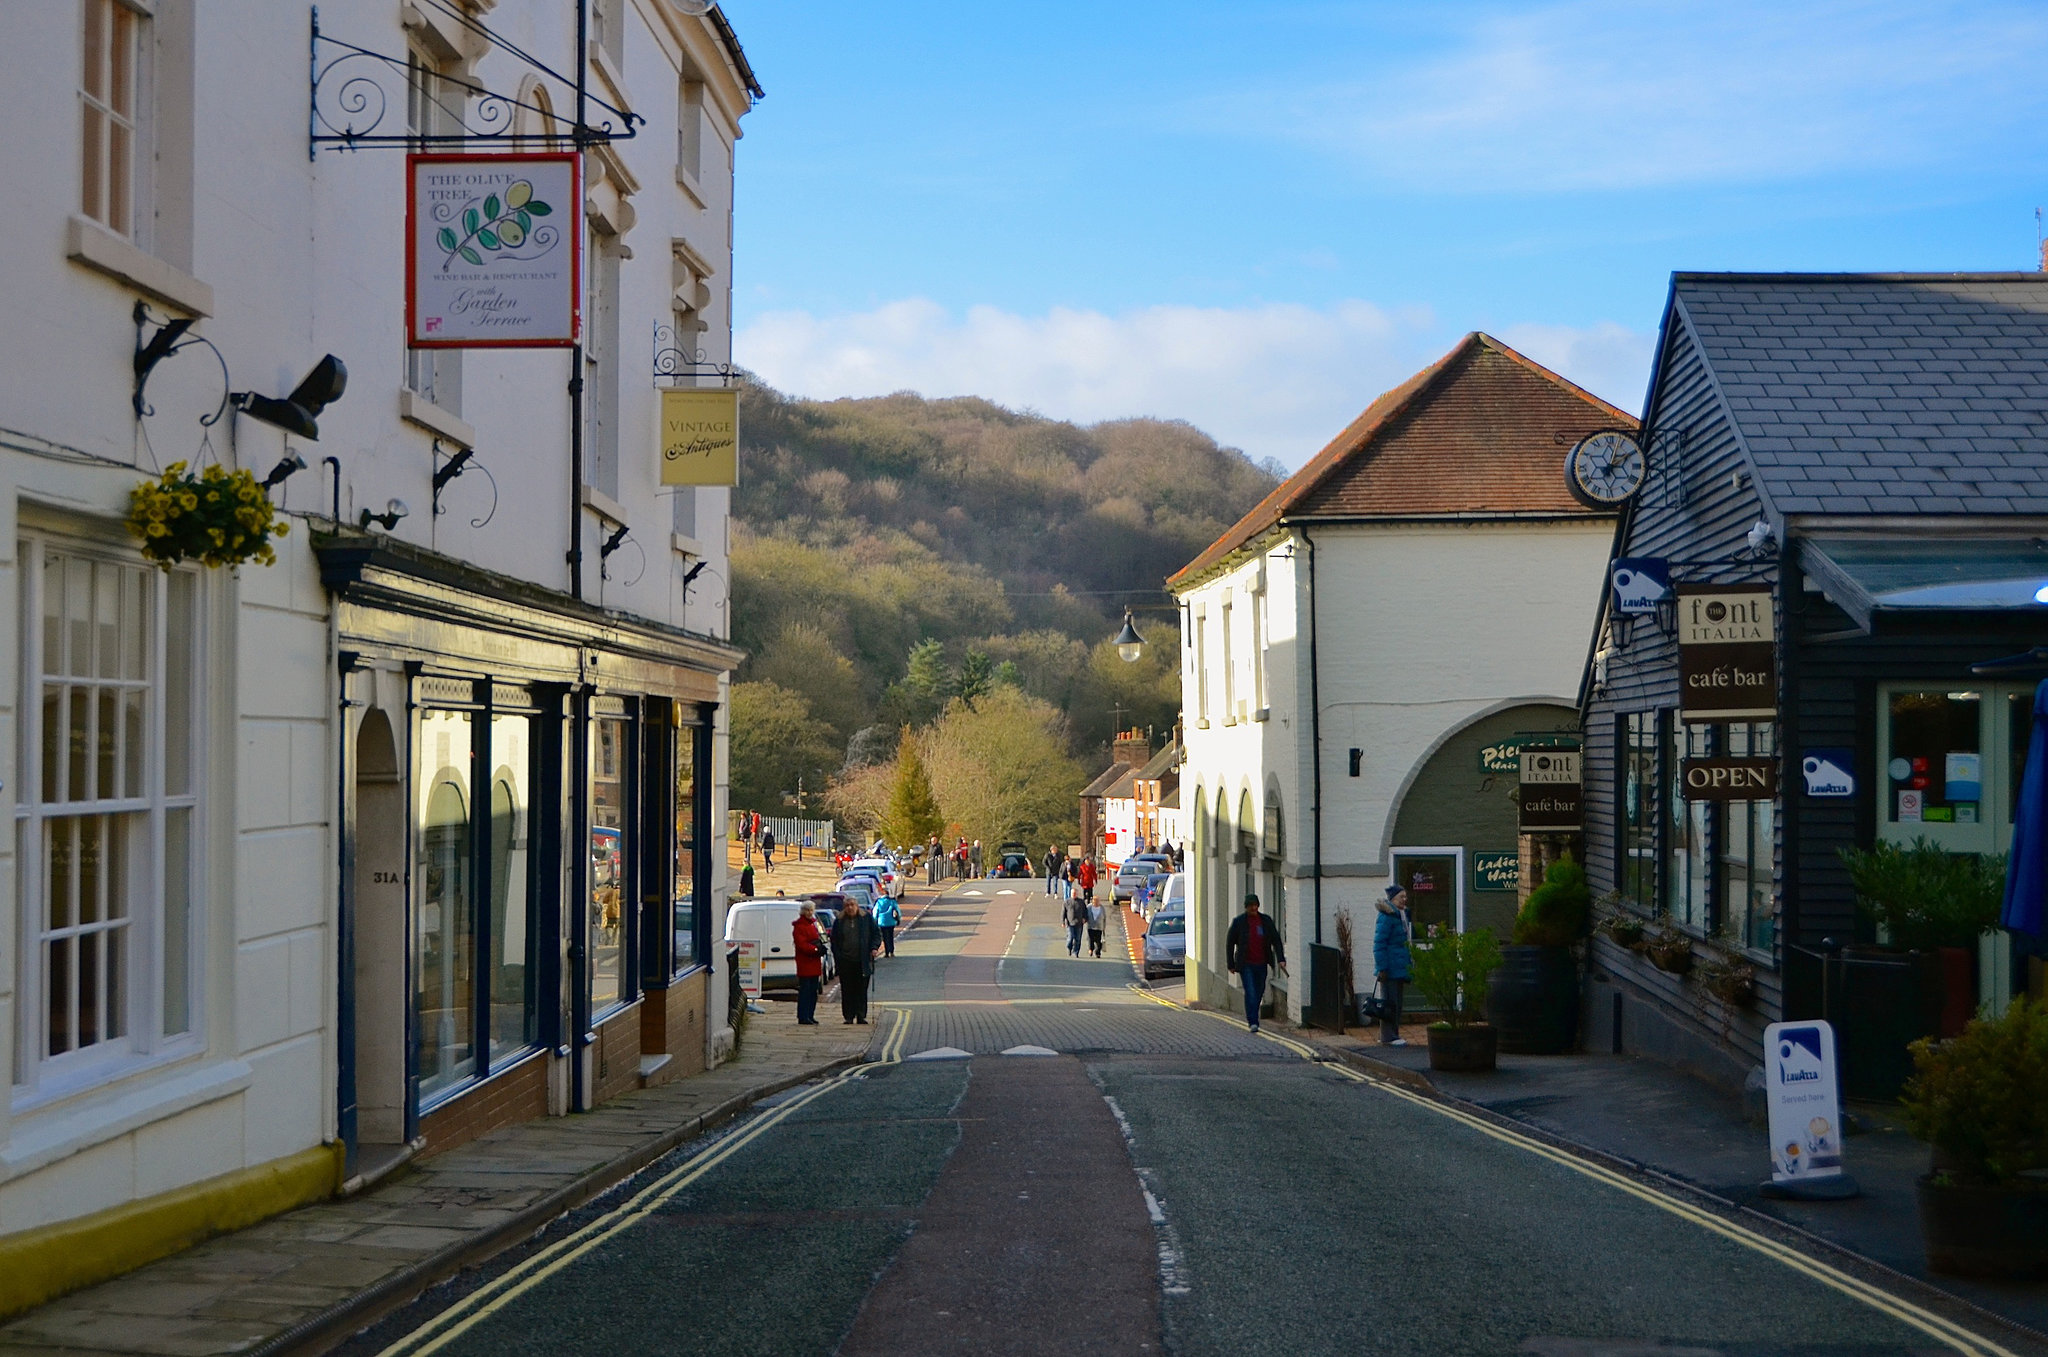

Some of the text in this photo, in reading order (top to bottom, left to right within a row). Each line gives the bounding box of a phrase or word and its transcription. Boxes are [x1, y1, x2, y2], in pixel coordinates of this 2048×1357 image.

[427, 174, 515, 185] THE OLIVE
[427, 190, 471, 200] TREE
[433, 272, 557, 281] WINE BAR & RESTAURANT
[476, 286, 497, 295] with
[449, 288, 517, 315] Garden
[471, 311, 532, 327] Terrace
[1692, 627, 1761, 640] ITALIA
[1688, 664, 1766, 687] café bar
[1528, 774, 1572, 782] ITALIA
[1687, 767, 1767, 788] OPEN
[1811, 783, 1847, 793] LAVAZZA
[1525, 796, 1576, 811] café bar
[374, 871, 399, 883] 31A
[1786, 1069, 1818, 1081] LAVAZZA
[1781, 1094, 1824, 1104] Served here
